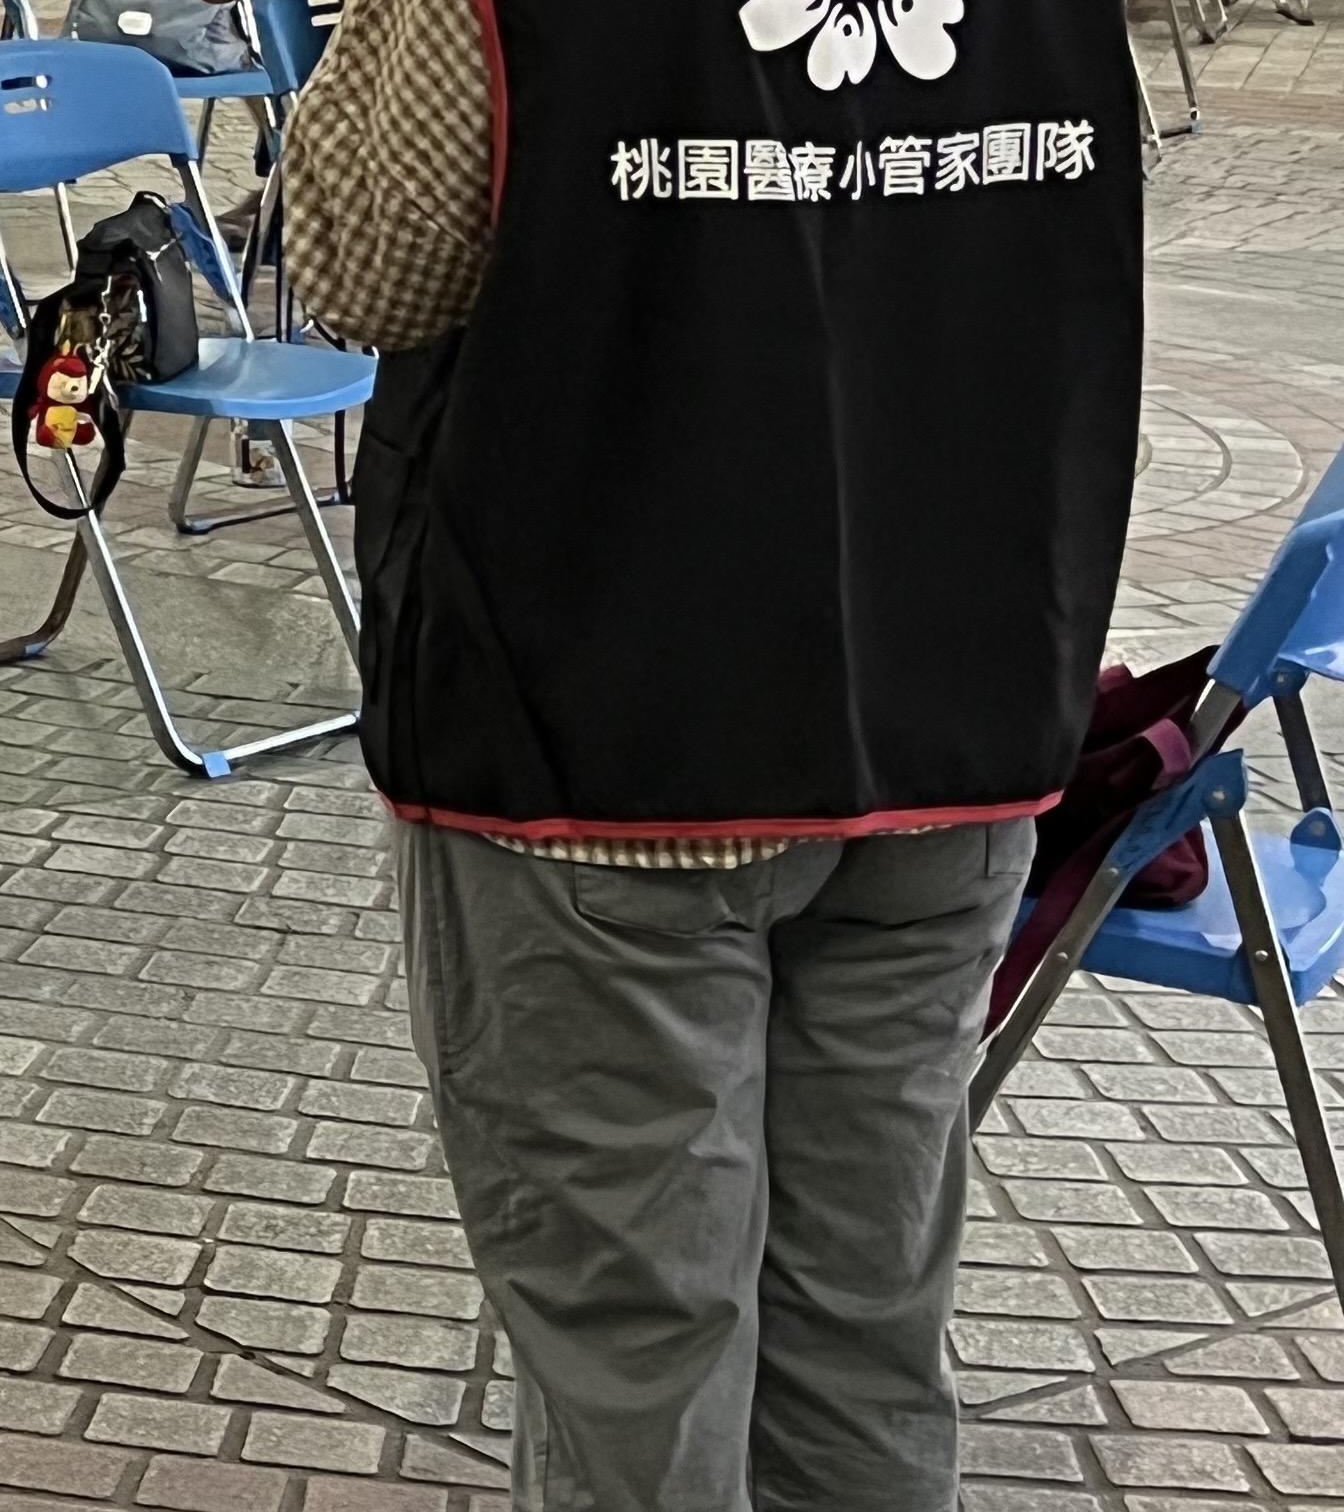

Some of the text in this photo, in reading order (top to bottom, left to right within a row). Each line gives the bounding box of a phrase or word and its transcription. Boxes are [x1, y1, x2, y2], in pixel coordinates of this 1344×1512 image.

[610, 119, 1096, 202] 桃園醫療小管家團隊
